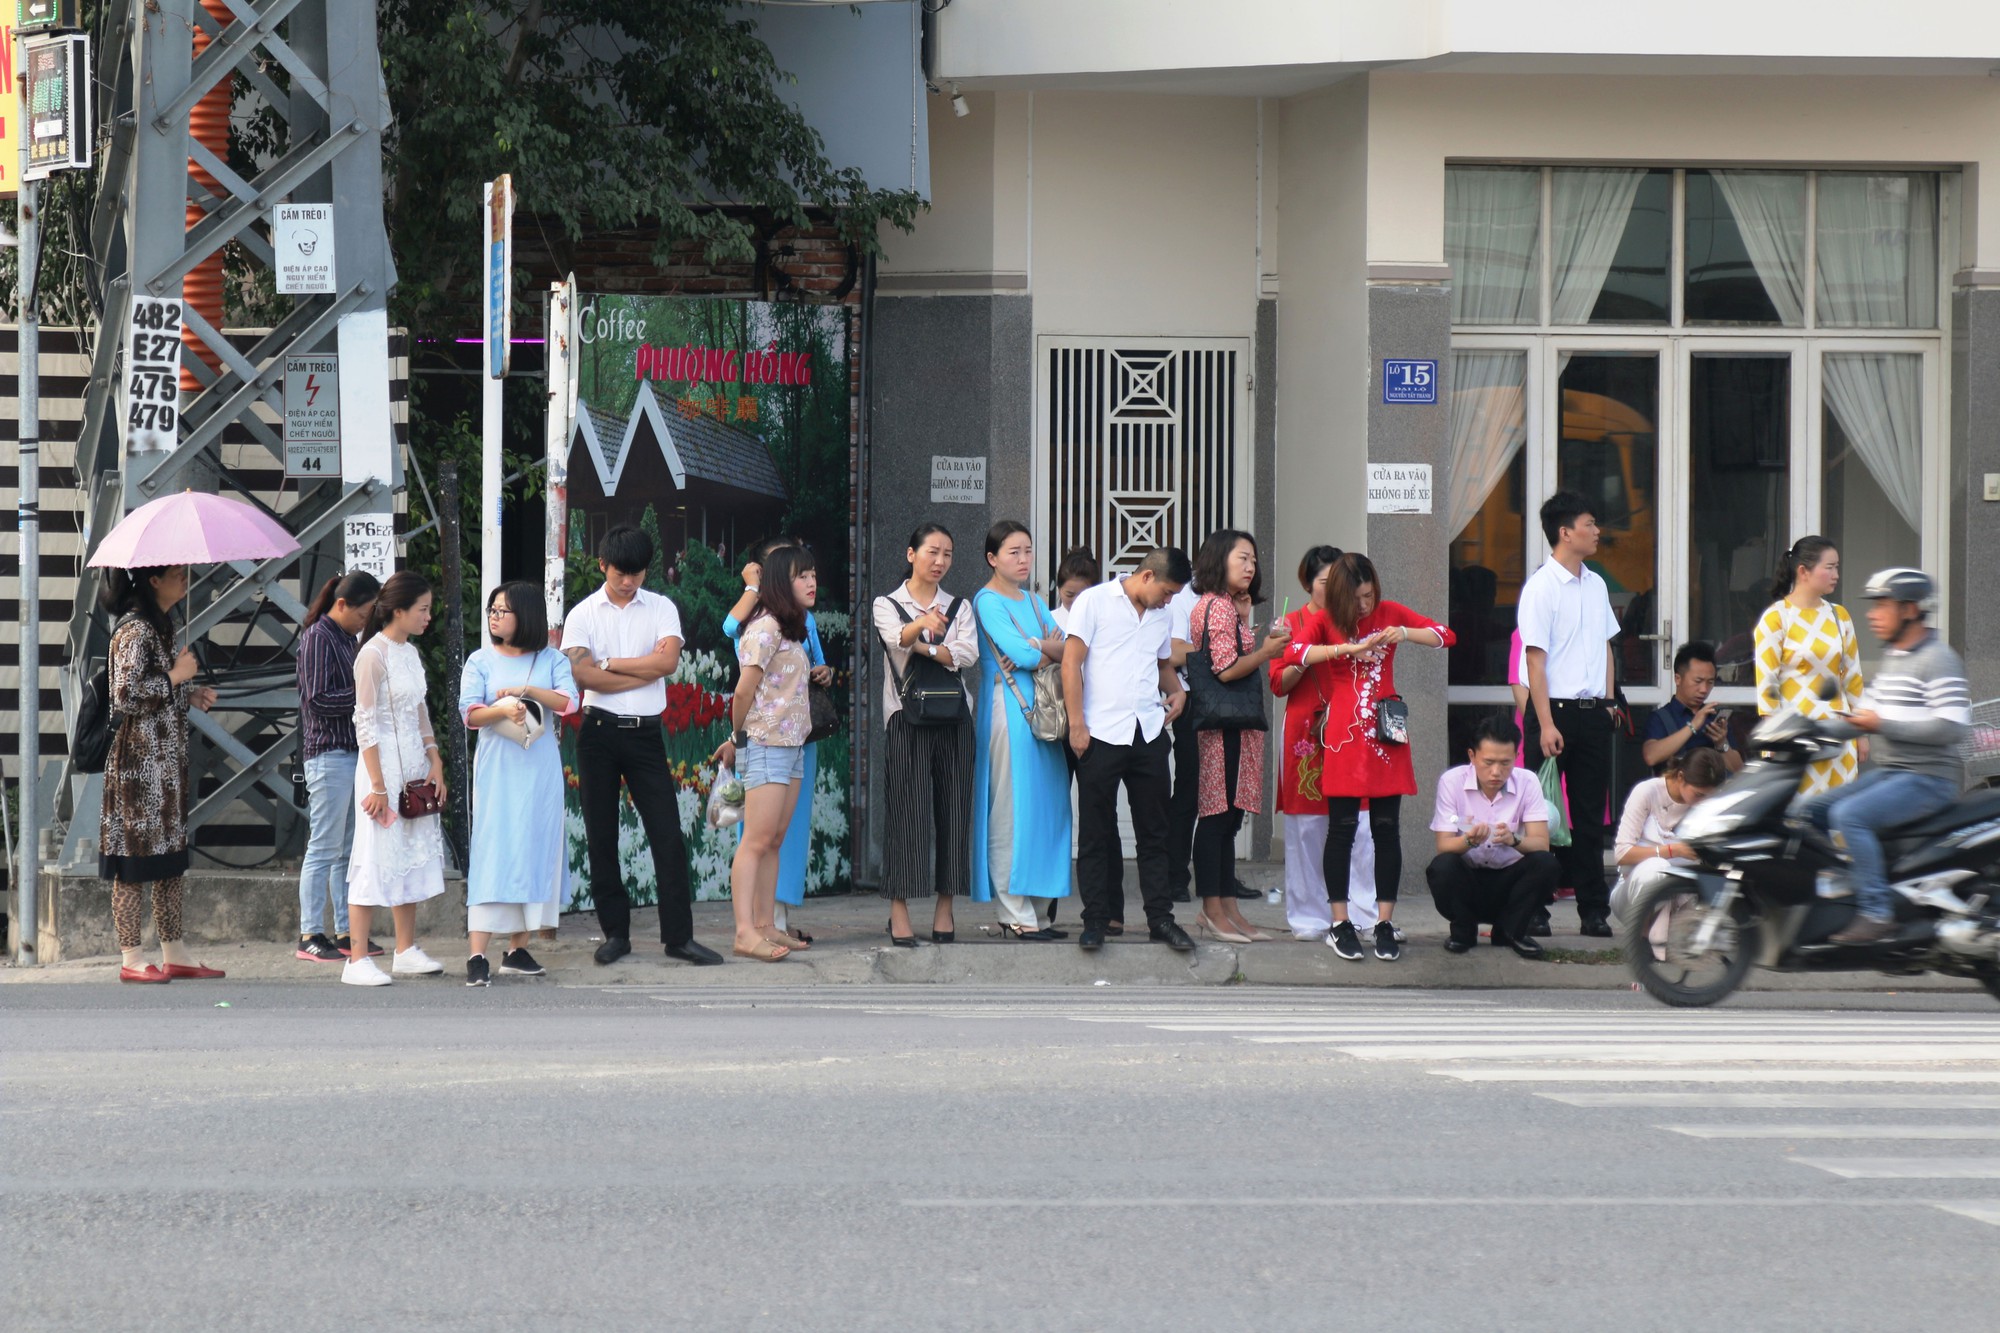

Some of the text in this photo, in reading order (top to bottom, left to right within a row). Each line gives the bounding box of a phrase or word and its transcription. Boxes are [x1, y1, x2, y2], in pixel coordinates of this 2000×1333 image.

[282, 208, 299, 220] CẤM
[285, 281, 304, 290] CHẾT
[133, 303, 181, 331] 482
[578, 306, 647, 344] Coffee
[133, 333, 181, 362] E27
[287, 359, 307, 372] CẤM
[635, 343, 739, 388] PHƯỢNG
[1401, 365, 1431, 386] 15
[129, 373, 177, 402] 475
[129, 402, 175, 432] 479
[288, 409, 306, 418] ĐIỆN
[308, 408, 318, 417] ÁP
[289, 428, 335, 437] CHẾT NGƯỜI
[302, 457, 321, 471] 44
[936, 458, 982, 471] CỬA RA VÀO
[1373, 467, 1427, 480] CỬA RA VÀO
[973, 479, 984, 490] XE
[1369, 486, 1401, 499] KHÔNG
[1418, 489, 1430, 500] XE
